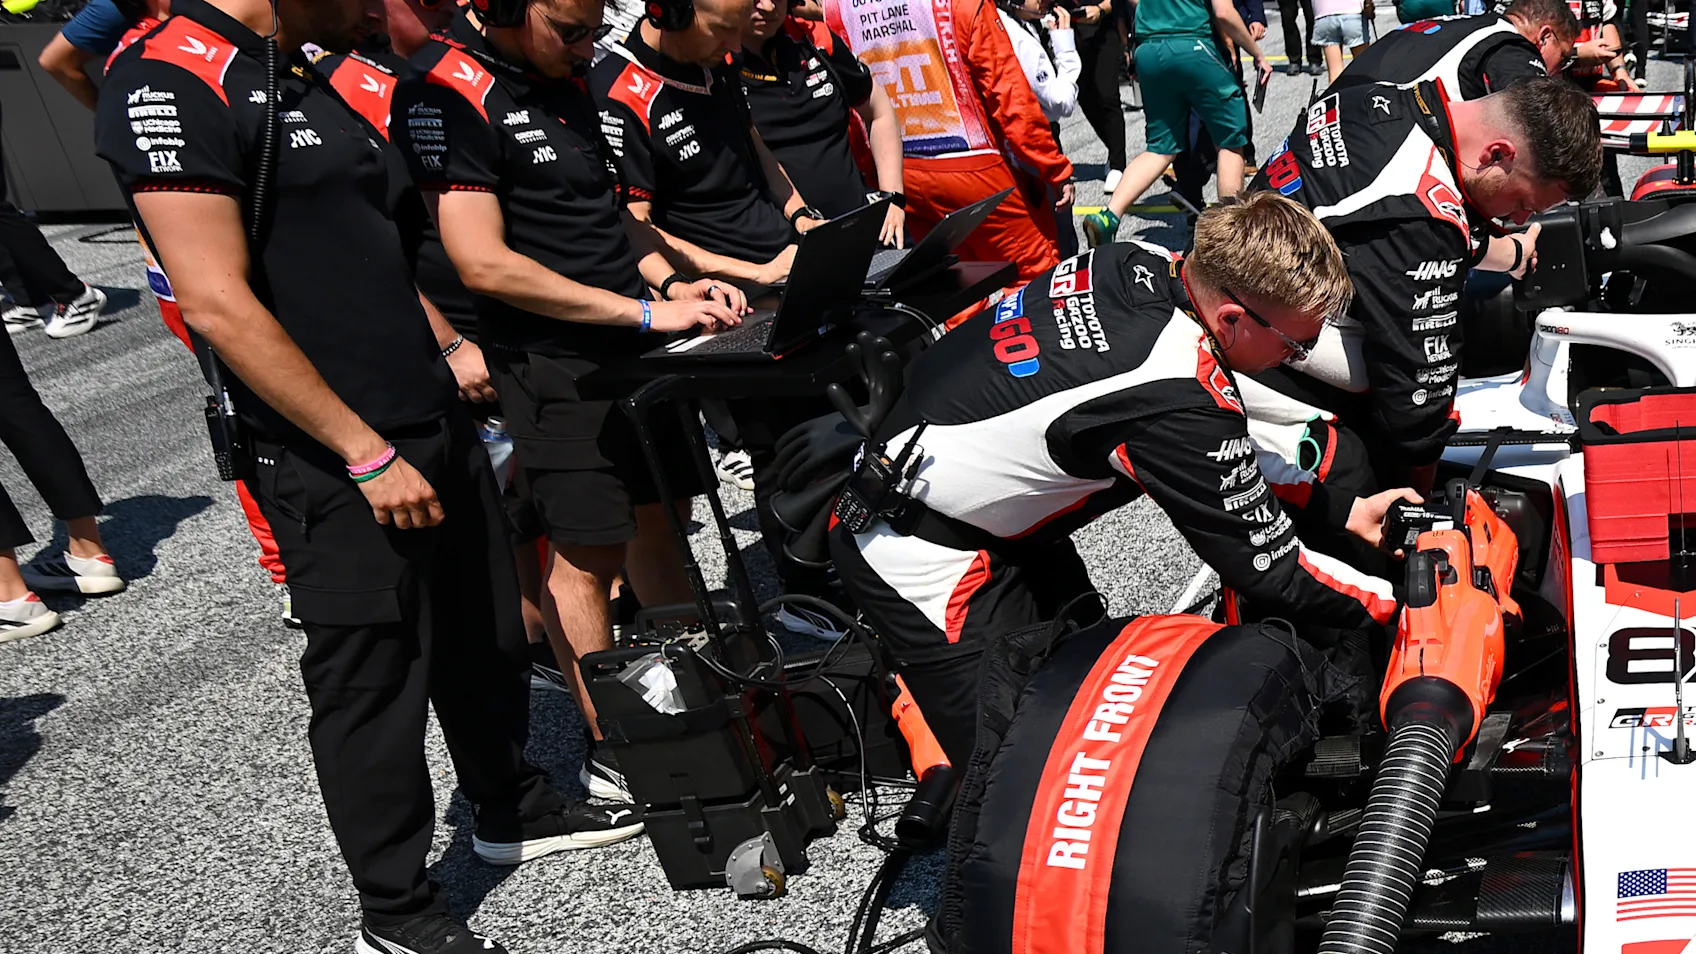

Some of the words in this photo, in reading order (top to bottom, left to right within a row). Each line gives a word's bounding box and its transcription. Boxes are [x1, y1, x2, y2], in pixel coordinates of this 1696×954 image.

[859, 13, 880, 25] PIT
[880, 4, 910, 24] LANE
[861, 20, 917, 42] MARSHAL
[142, 119, 180, 128] UChicago
[143, 126, 182, 134] Medicine
[150, 137, 185, 147] infobip
[1309, 132, 1325, 169] Racing
[1319, 128, 1338, 167] GAZOO
[1330, 123, 1350, 168] TOYOTA
[148, 150, 181, 167] FIX
[421, 155, 443, 168] FIX
[1053, 259, 1078, 294] GR
[1405, 258, 1464, 281] HAAS
[1432, 292, 1459, 304] RUCKUS
[1053, 299, 1077, 350] Racing
[1065, 297, 1093, 350] GAZOO
[1080, 292, 1111, 353] TOYOTA
[1412, 311, 1458, 331] PIRELLI
[989, 316, 1041, 364] GO
[1424, 334, 1451, 356] FIX
[1610, 712, 1674, 728] GR
[1046, 751, 1107, 870] RIGHT
[1083, 654, 1161, 745] FRONT
